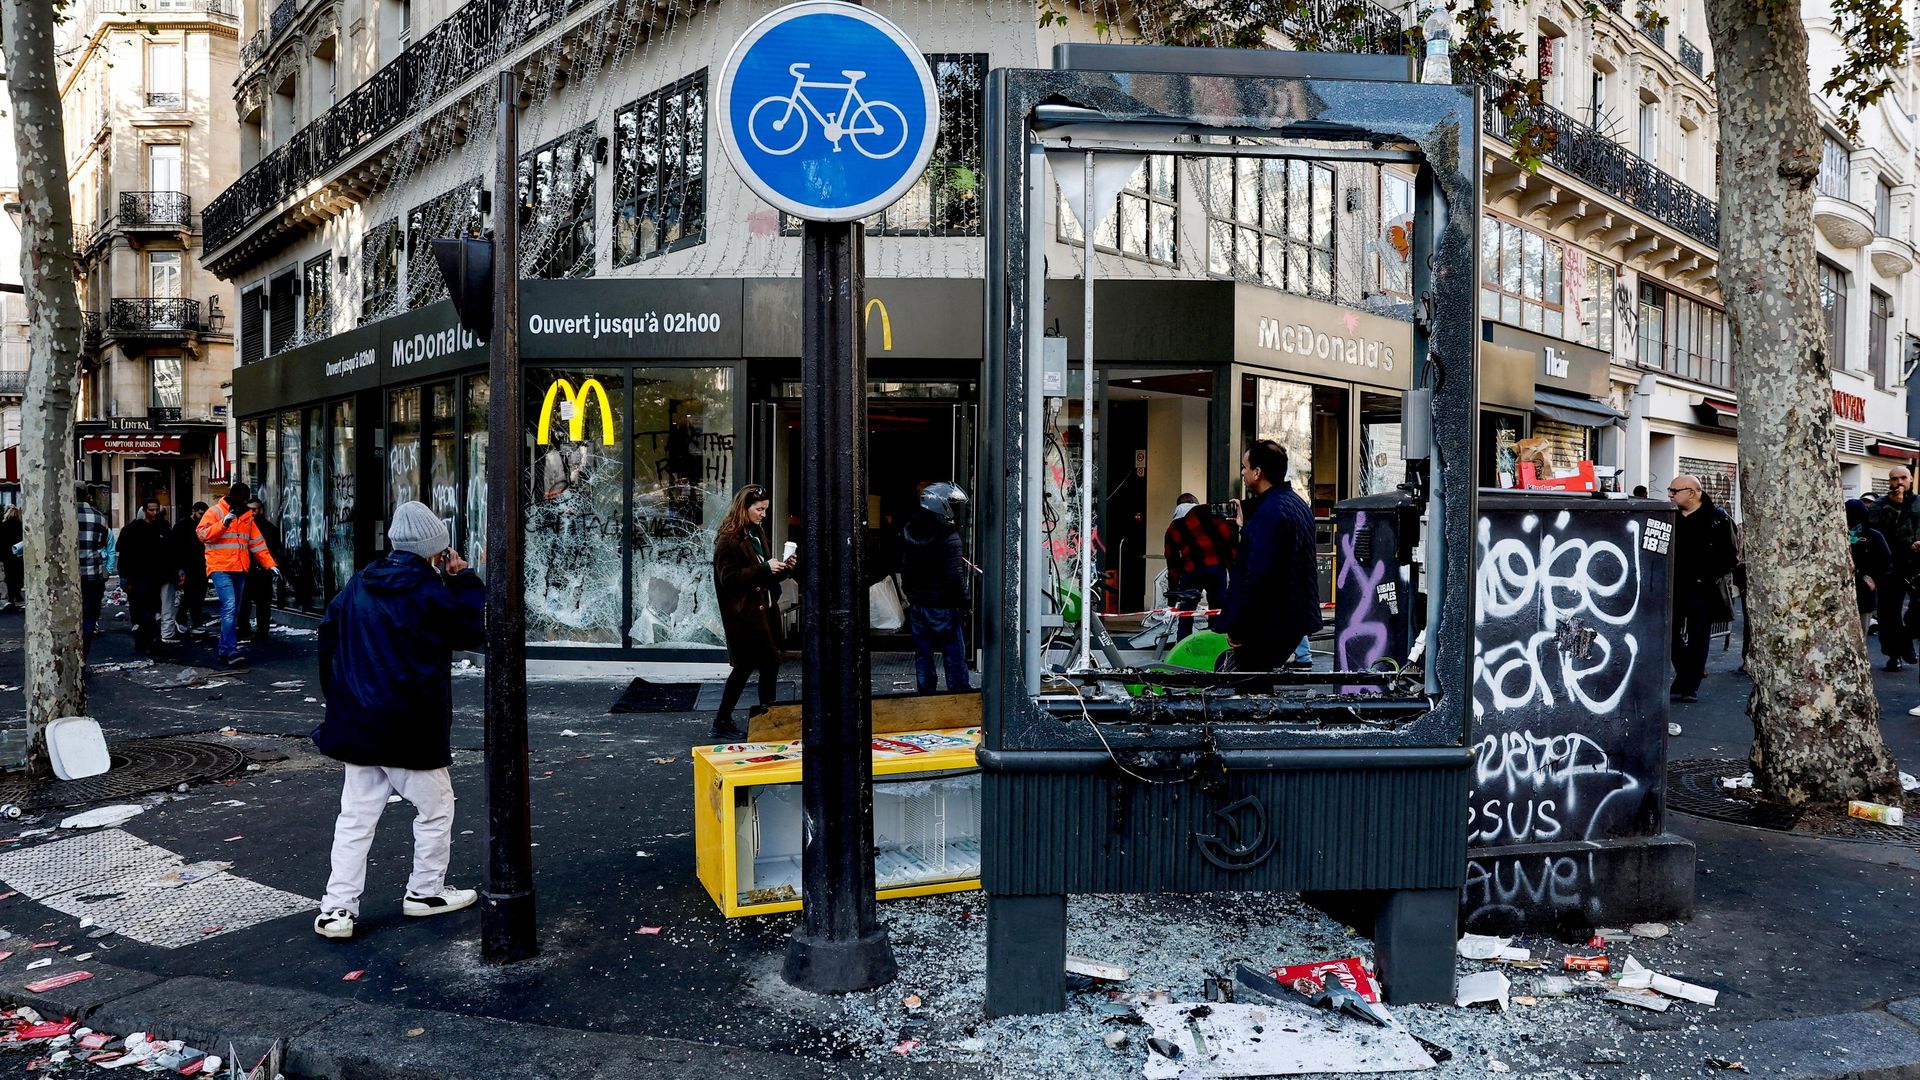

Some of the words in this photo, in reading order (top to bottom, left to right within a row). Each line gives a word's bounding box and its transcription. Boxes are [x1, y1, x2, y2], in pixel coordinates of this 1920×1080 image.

[529, 314, 590, 334] Ouvert
[663, 312, 721, 333] 02h00
[391, 322, 487, 368] McDonald
[325, 358, 342, 376] Ouvert
[359, 348, 376, 368] 02h00
[104, 440, 134, 448] COMPTOIR
[135, 440, 161, 448] PARISIEN
[1645, 527, 1670, 541] APPLES
[1642, 536, 1658, 552] 18
